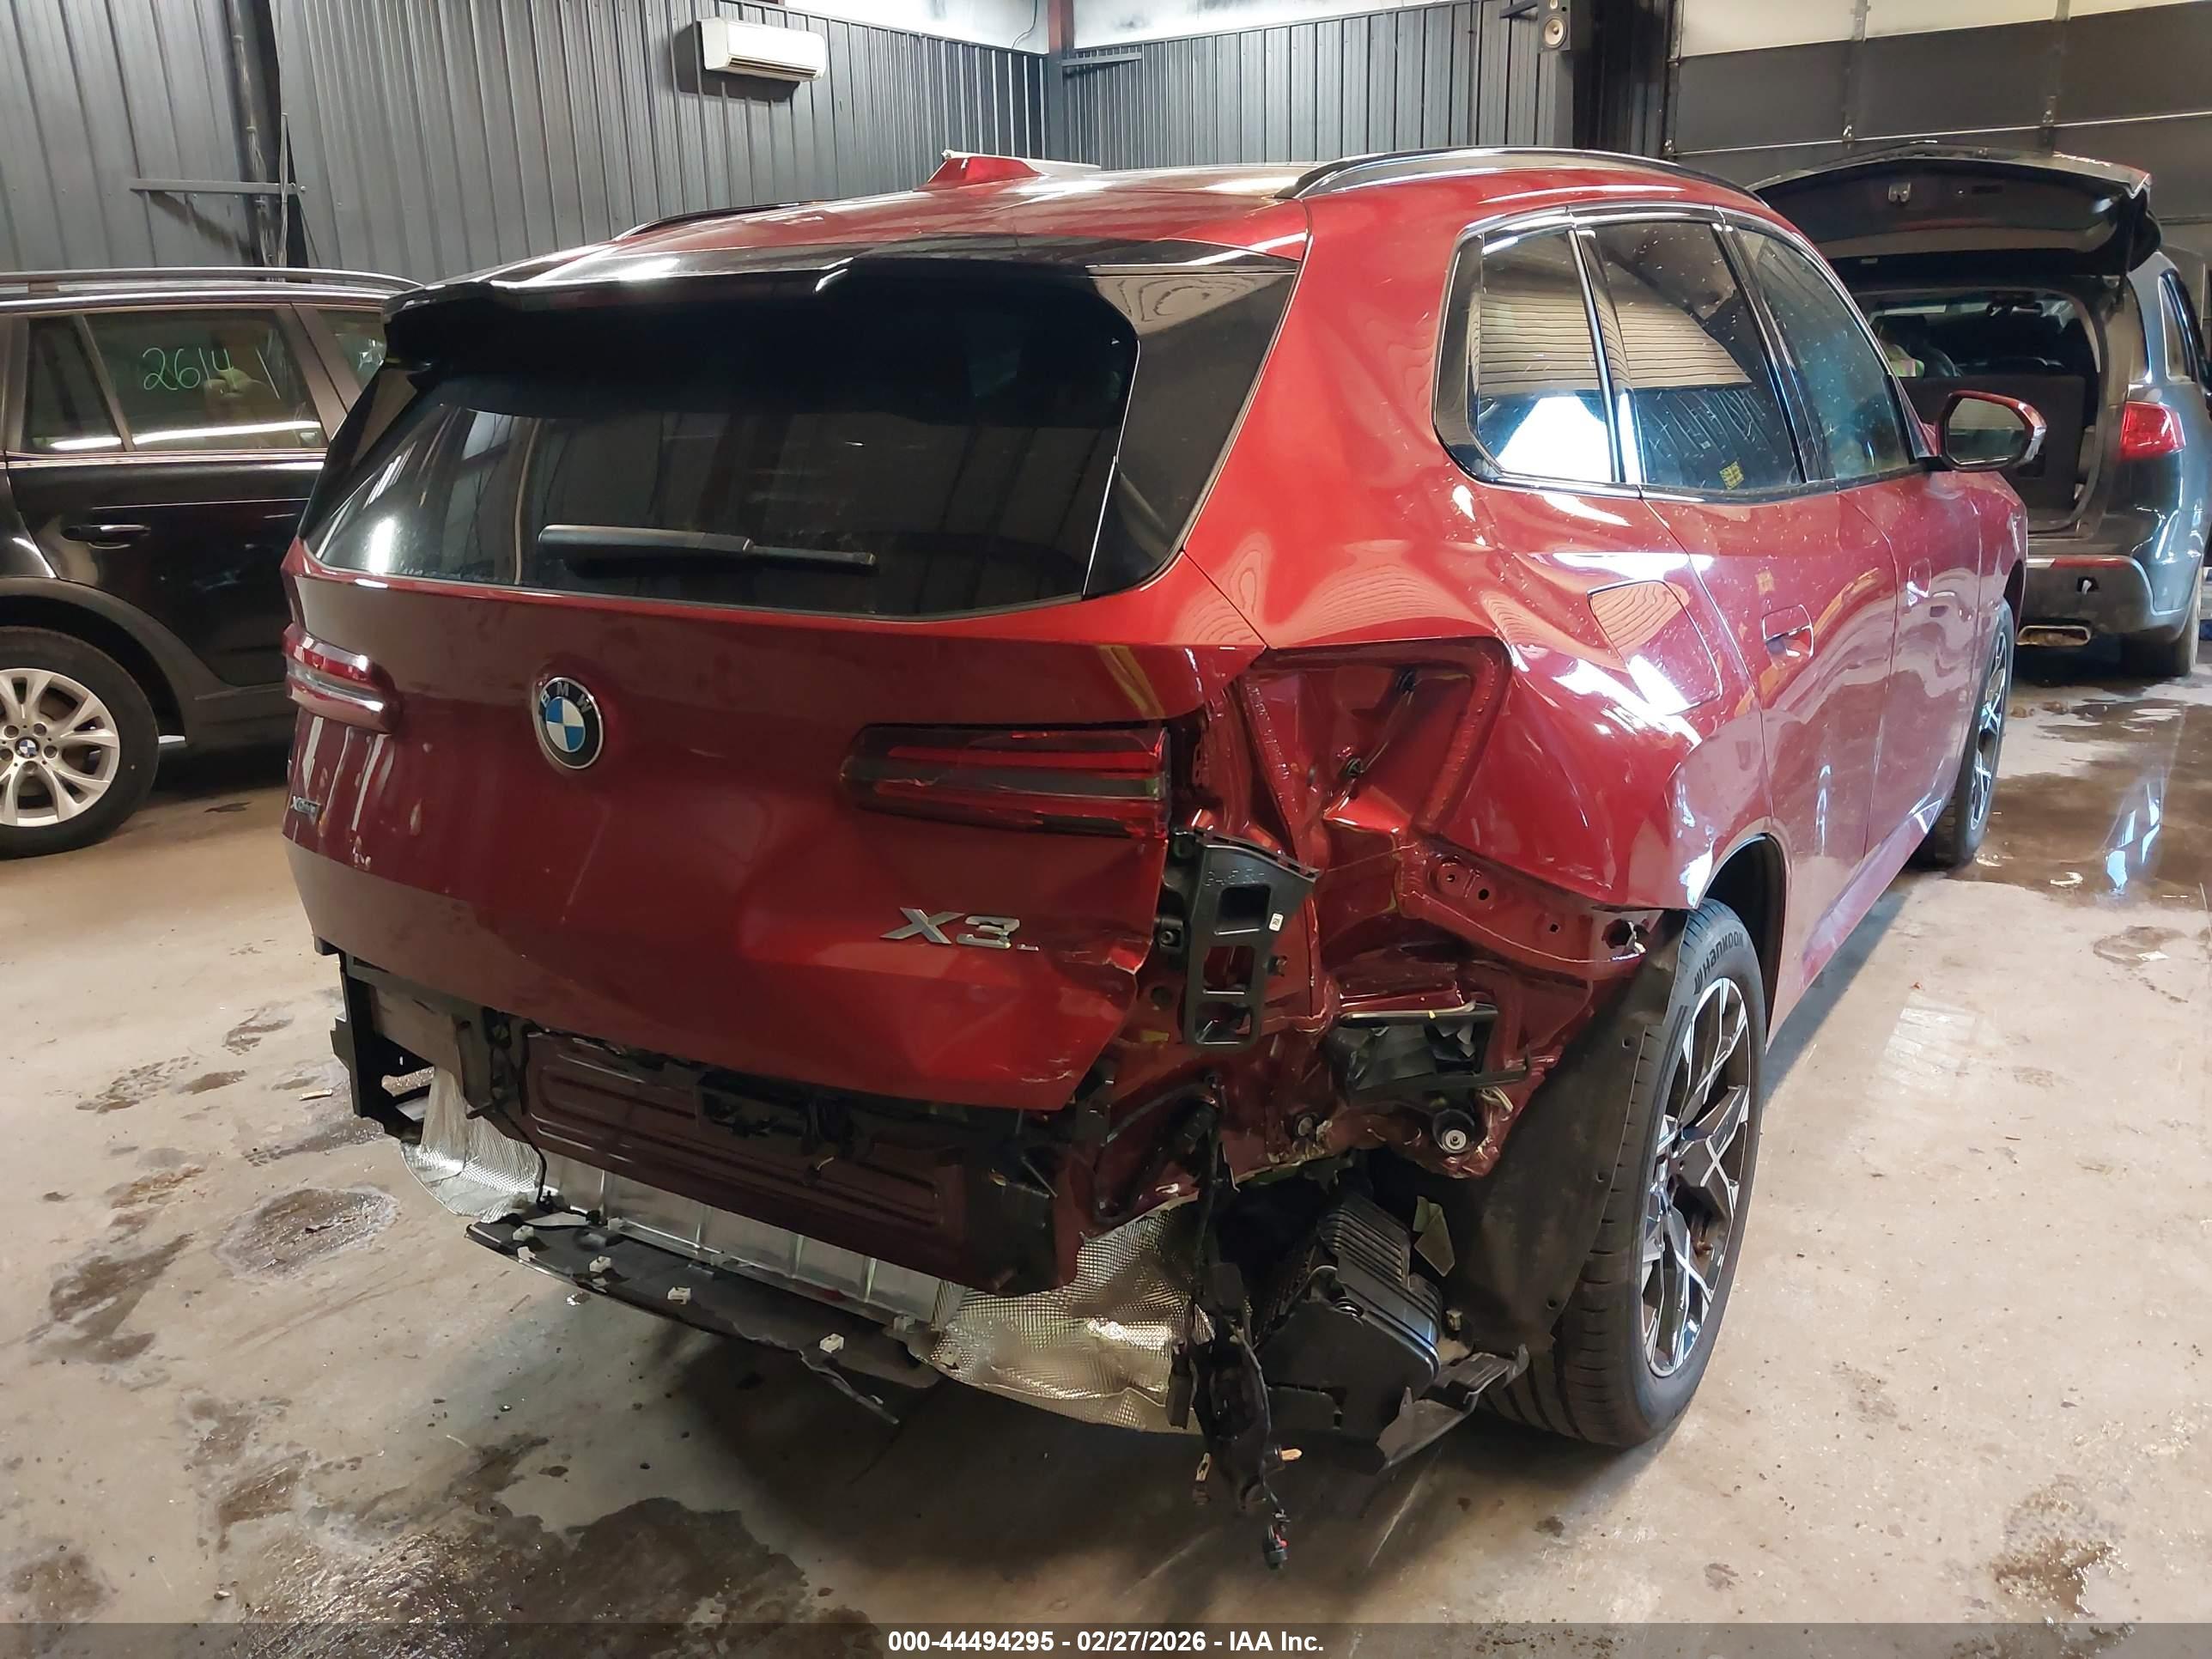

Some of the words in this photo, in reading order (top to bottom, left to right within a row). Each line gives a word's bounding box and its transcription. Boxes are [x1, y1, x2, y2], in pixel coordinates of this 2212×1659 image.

[142, 347, 239, 391] 2614
[540, 681, 592, 714] BMW
[878, 906, 1021, 950] X3
